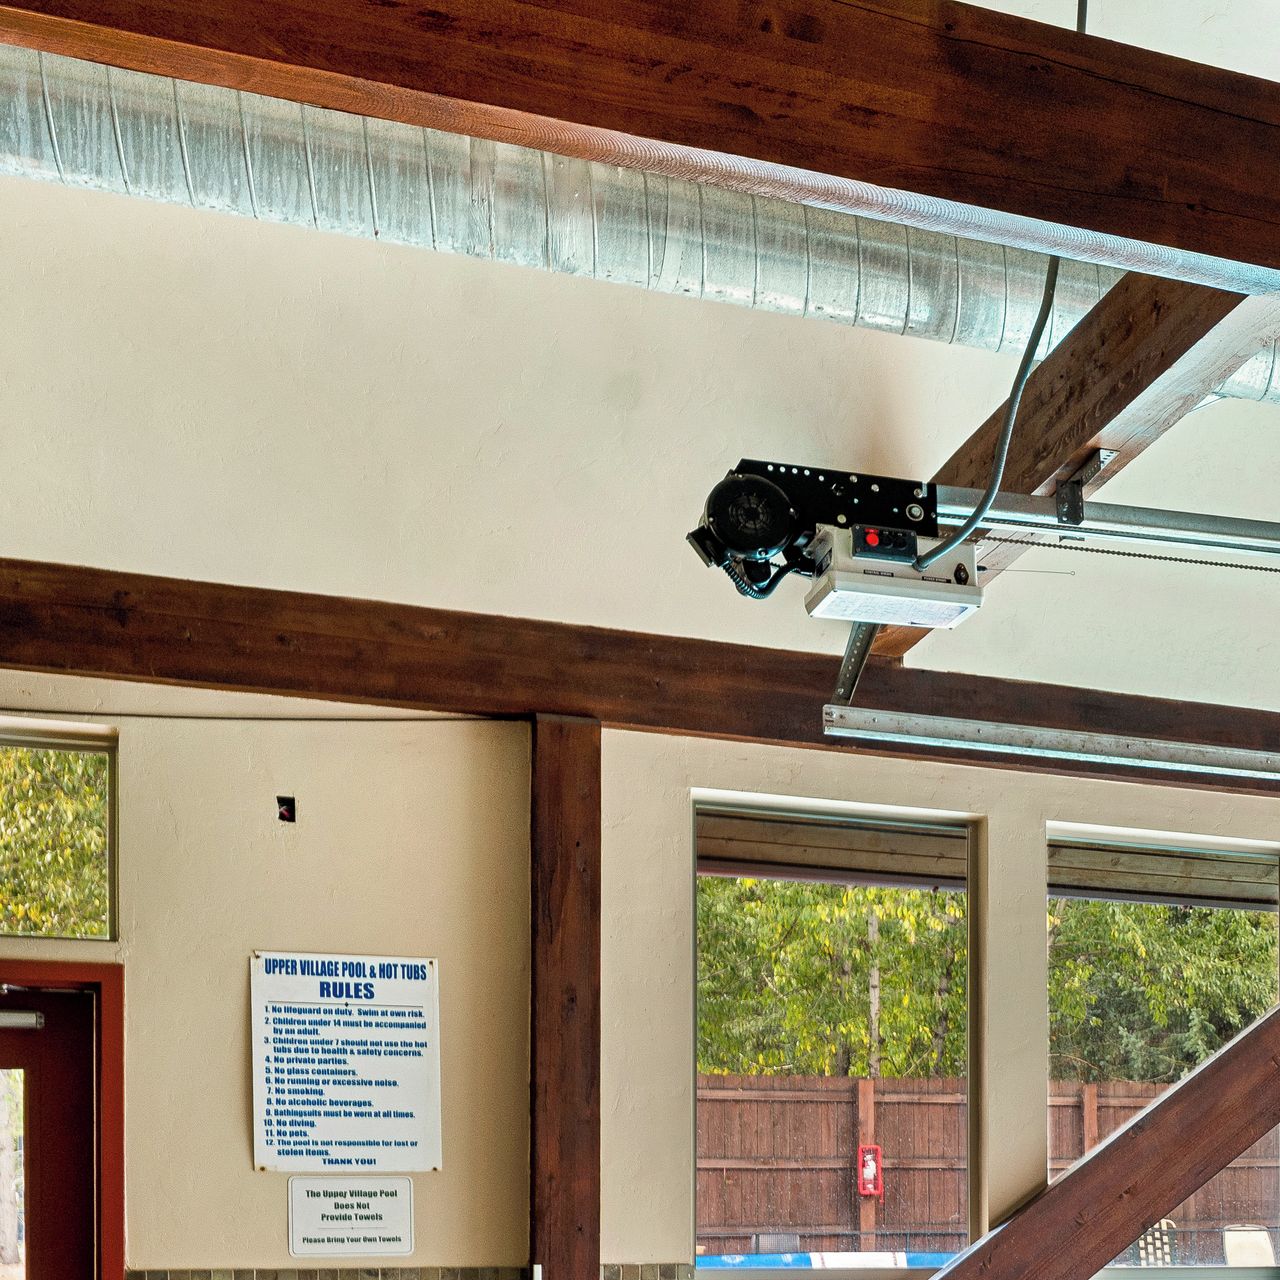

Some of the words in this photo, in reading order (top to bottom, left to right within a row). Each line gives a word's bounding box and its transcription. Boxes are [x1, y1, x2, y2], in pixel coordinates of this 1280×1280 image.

[265, 958, 297, 975] UPPER
[300, 960, 339, 977] VILLAGE
[342, 961, 367, 978] POOL
[369, 965, 376, 978] &
[379, 963, 398, 979] HOT
[400, 964, 427, 980] TUBS
[320, 981, 375, 999] RULES
[284, 1007, 321, 1015] lifeguard
[335, 1008, 354, 1017] duty.
[358, 1008, 379, 1016] Swim
[273, 1017, 307, 1026] Children
[333, 1019, 341, 1027] 14
[375, 1021, 427, 1030] accompanied
[273, 1027, 283, 1035] by
[310, 1038, 333, 1046] under
[341, 1039, 368, 1047] should
[321, 1047, 347, 1055] health
[357, 1048, 381, 1057] safety
[384, 1049, 423, 1057] concerns.
[286, 1056, 316, 1065] private
[318, 1057, 349, 1066] parties.
[265, 1066, 272, 1074] 5.
[274, 1066, 285, 1074] No
[287, 1067, 309, 1075] glass
[311, 1068, 358, 1076] containers.
[265, 1076, 272, 1084] 6.
[274, 1077, 285, 1085] No
[287, 1077, 320, 1086] running
[287, 1087, 325, 1096] smoking.
[266, 1097, 273, 1105] 8.
[276, 1098, 286, 1106] No
[288, 1098, 327, 1106] alcoholic
[329, 1098, 374, 1107] beverages.
[274, 1109, 322, 1118] Bathingsuits
[264, 1119, 274, 1127] 10.
[276, 1119, 287, 1127] No
[289, 1119, 316, 1128] diving.
[265, 1129, 275, 1137] 11.
[289, 1130, 309, 1138] pets.
[349, 1190, 378, 1198] Village
